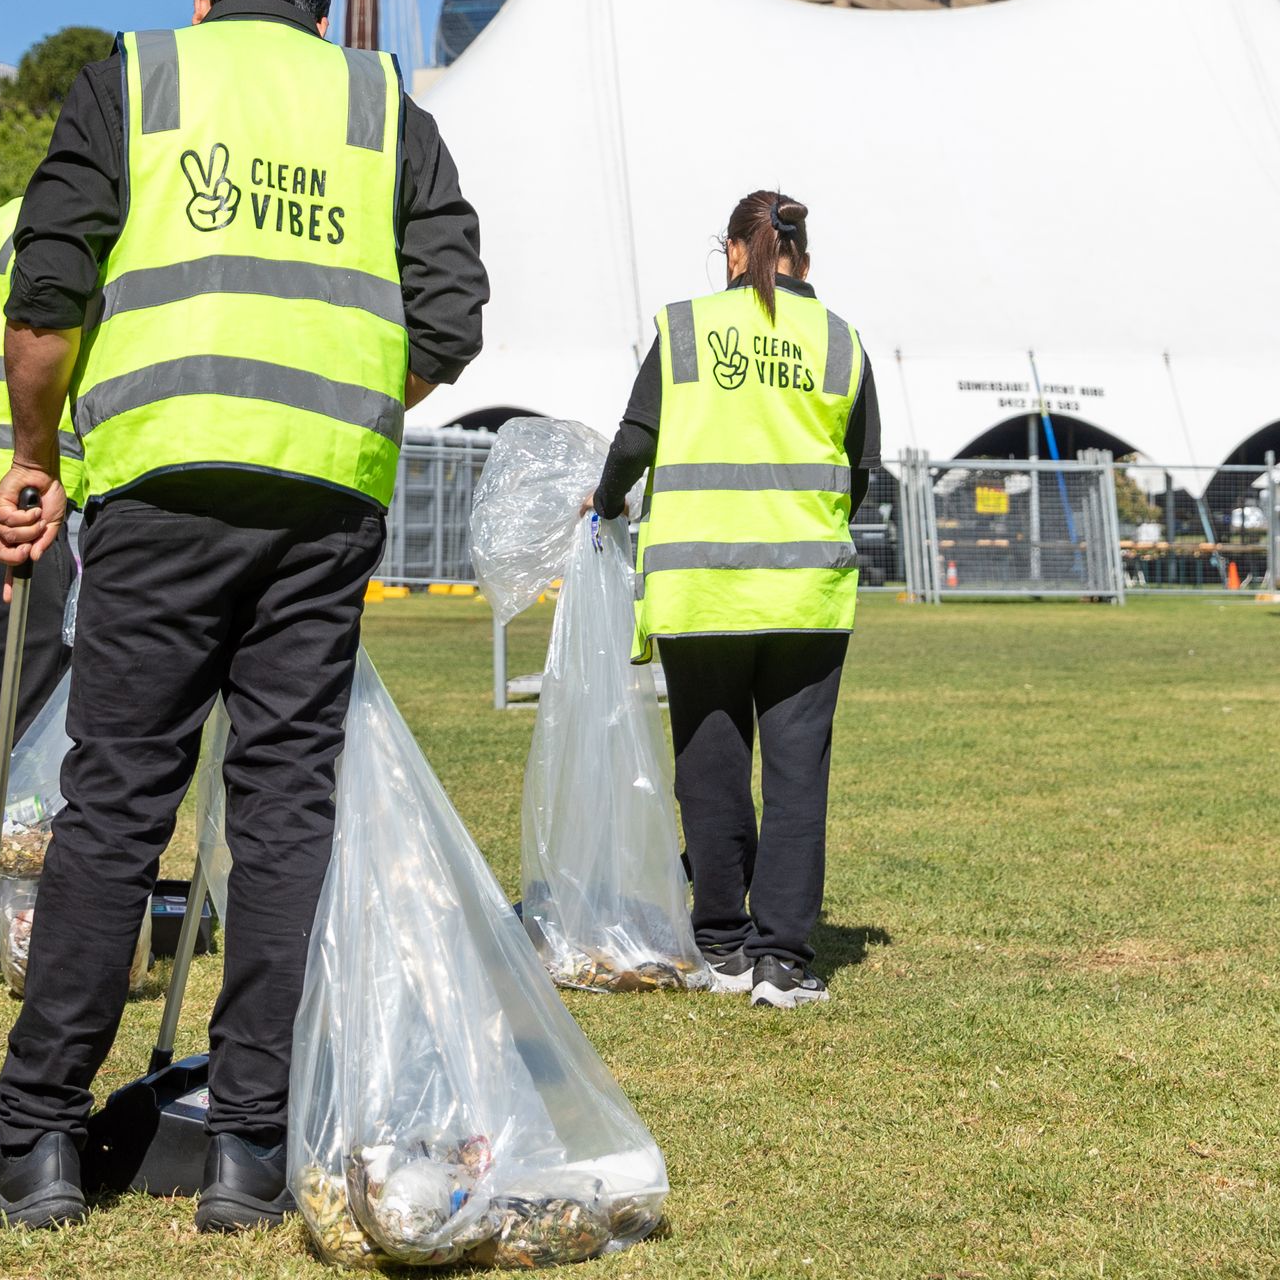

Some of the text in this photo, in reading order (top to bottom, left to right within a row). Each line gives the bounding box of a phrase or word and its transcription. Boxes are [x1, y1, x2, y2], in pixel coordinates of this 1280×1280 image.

[251, 158, 326, 197] CLEAN
[251, 192, 345, 245] VIBES
[753, 335, 802, 361] CLEAN
[755, 359, 815, 392] VIBES
